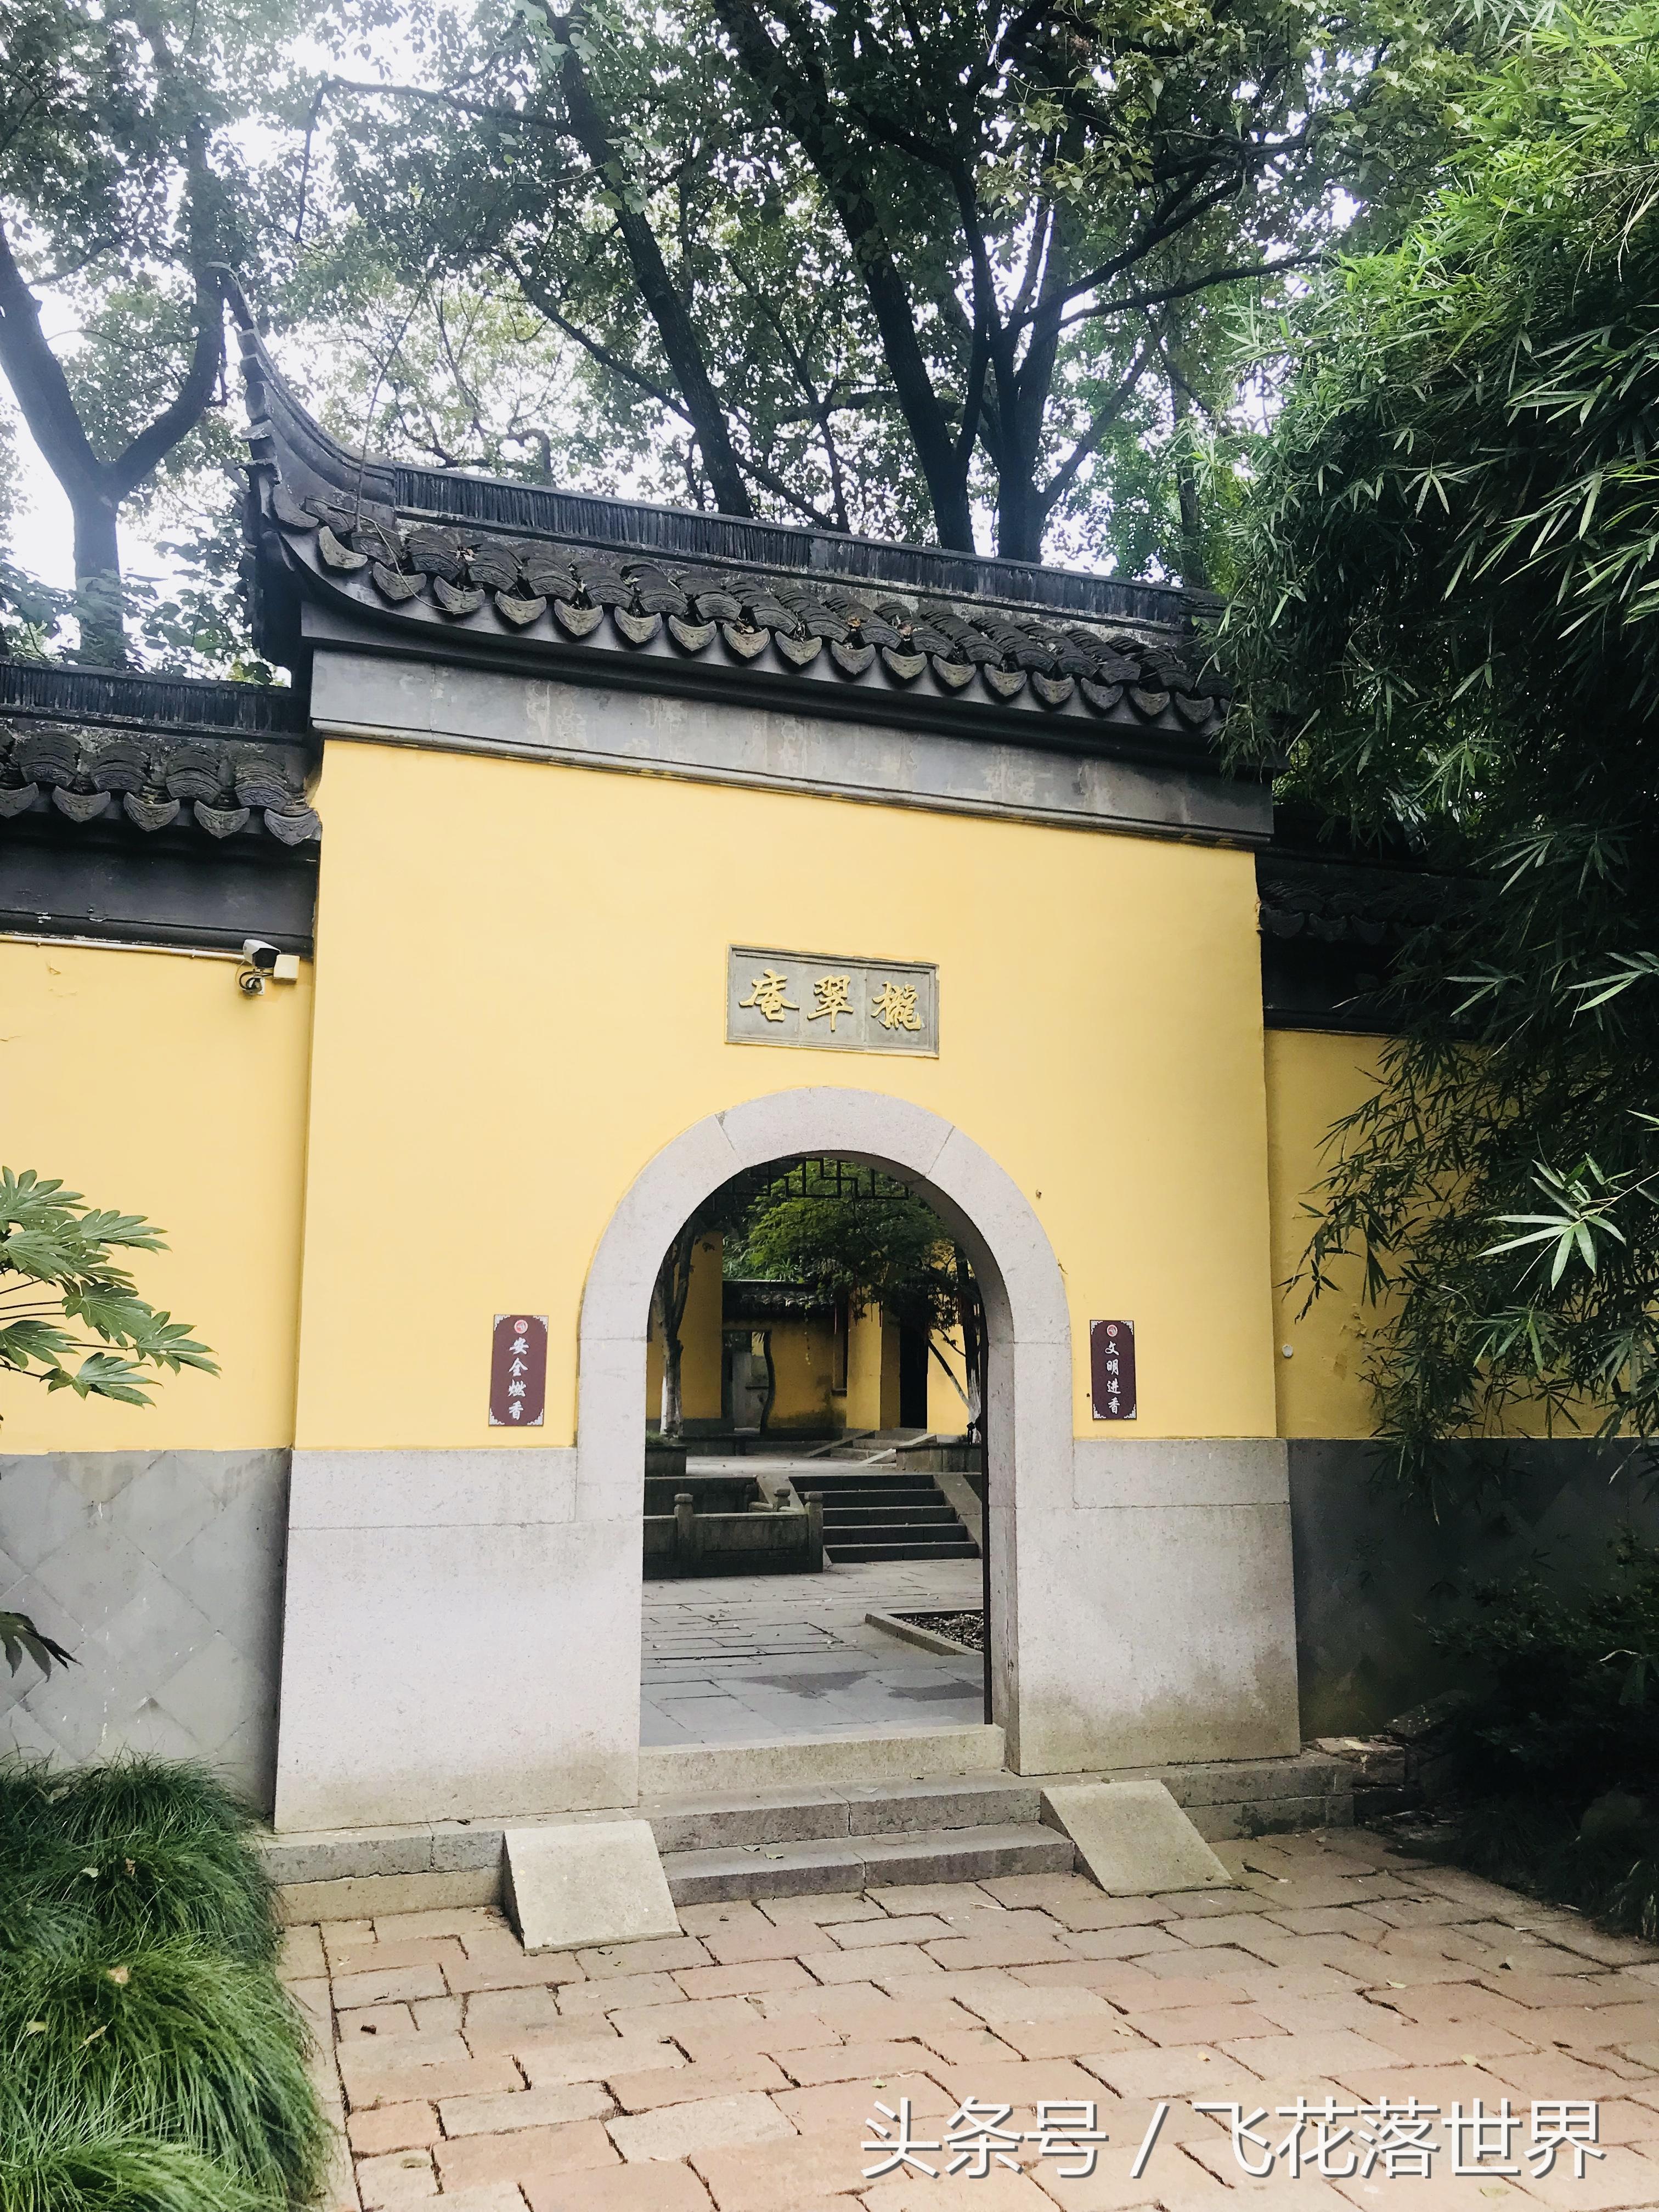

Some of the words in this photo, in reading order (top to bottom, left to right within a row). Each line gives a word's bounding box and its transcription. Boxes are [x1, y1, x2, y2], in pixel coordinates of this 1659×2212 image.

[508, 1337, 529, 1420] 安全燃香
[1105, 1341, 1121, 1414] 文明进香
